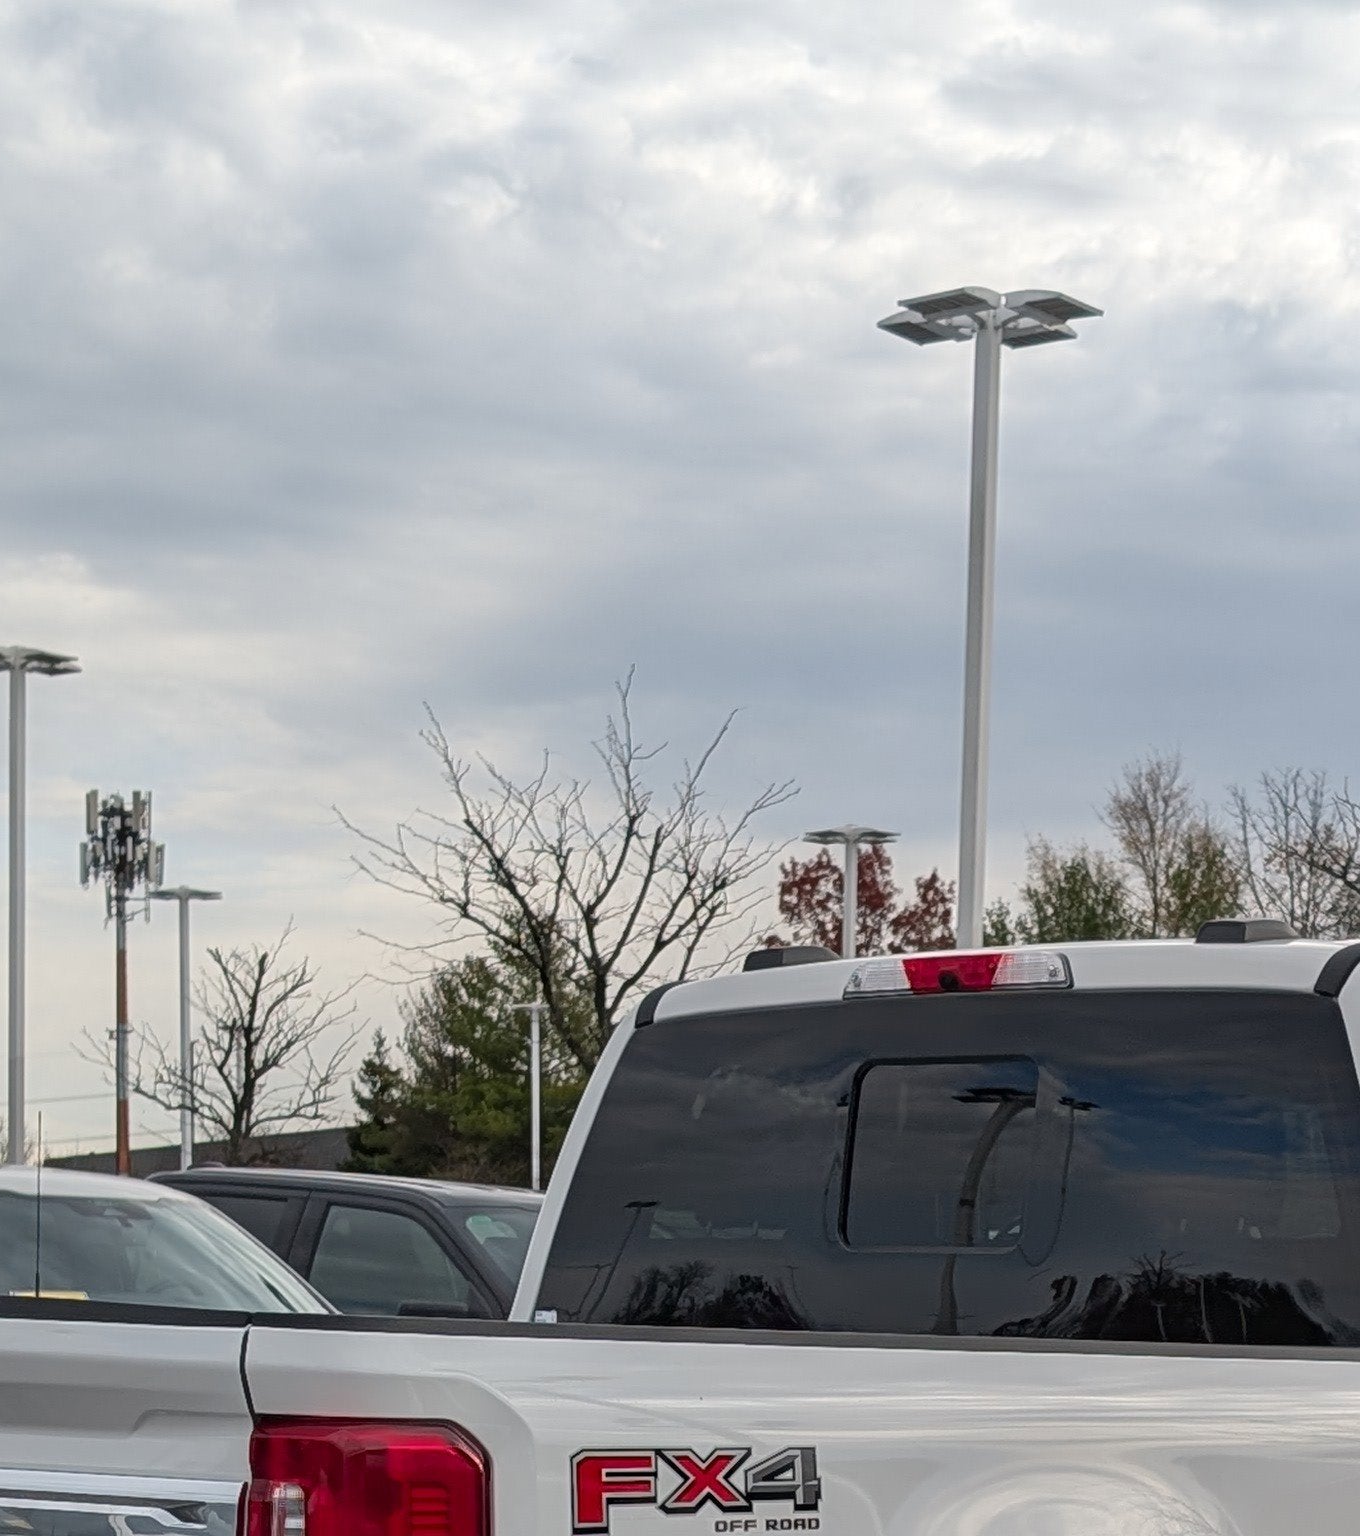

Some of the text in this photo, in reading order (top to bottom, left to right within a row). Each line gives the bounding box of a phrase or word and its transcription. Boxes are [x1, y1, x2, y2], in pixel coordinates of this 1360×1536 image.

[570, 1448, 822, 1535] FX4
[714, 1517, 821, 1533] OFF ROAD
